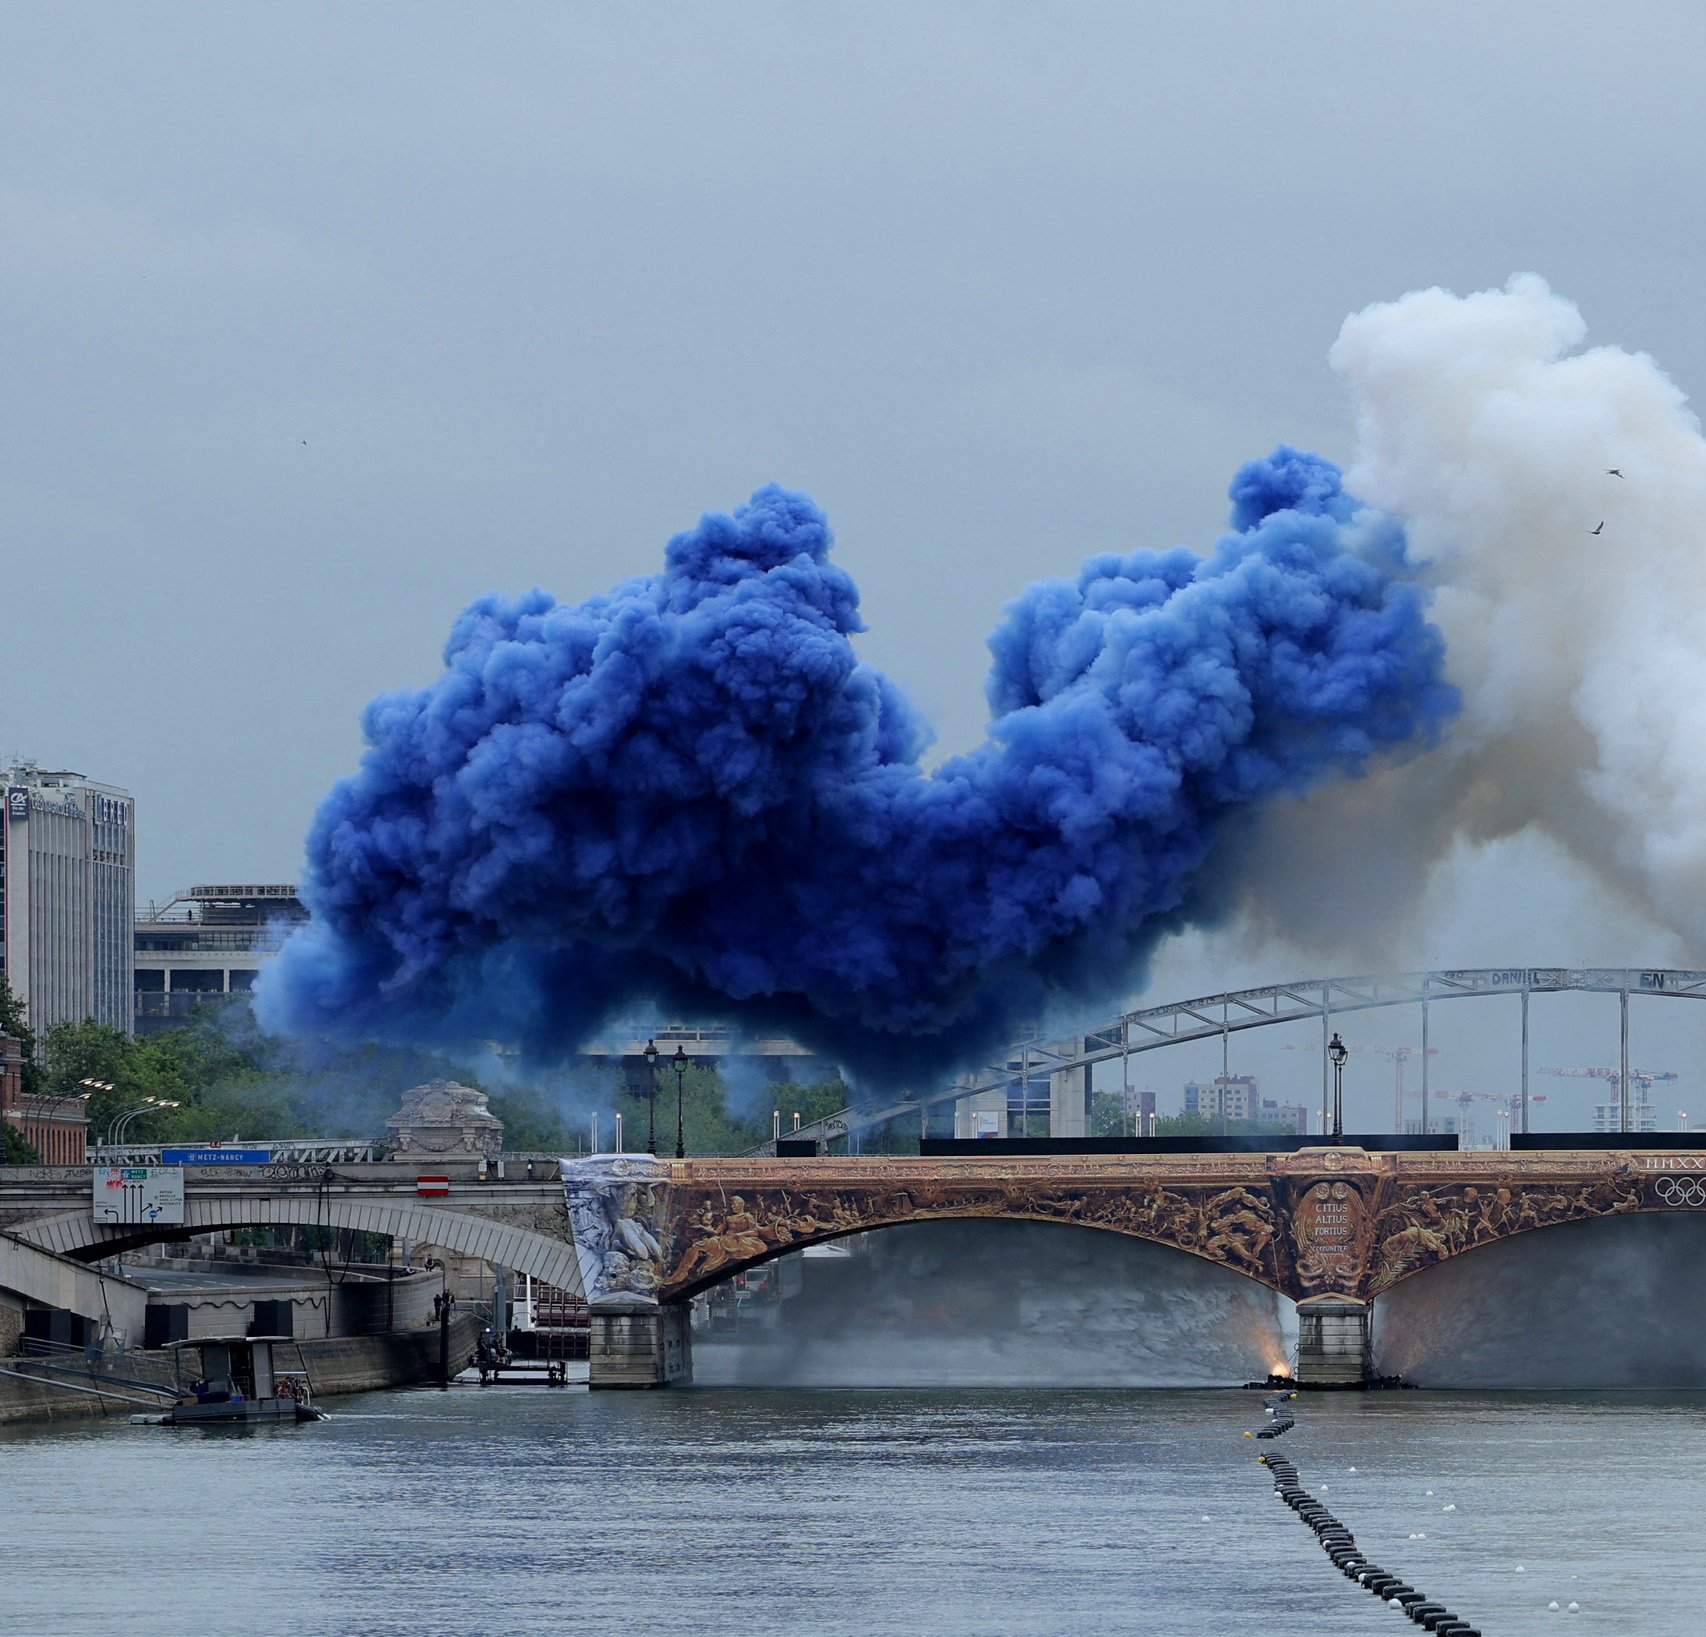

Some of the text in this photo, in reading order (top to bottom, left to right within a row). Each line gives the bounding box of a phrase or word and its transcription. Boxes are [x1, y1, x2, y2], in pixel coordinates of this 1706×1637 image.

[1315, 1203, 1348, 1213] CITIUS
[1315, 1215, 1348, 1224] ALTIUS
[1315, 1226, 1348, 1236] FORTIUS
